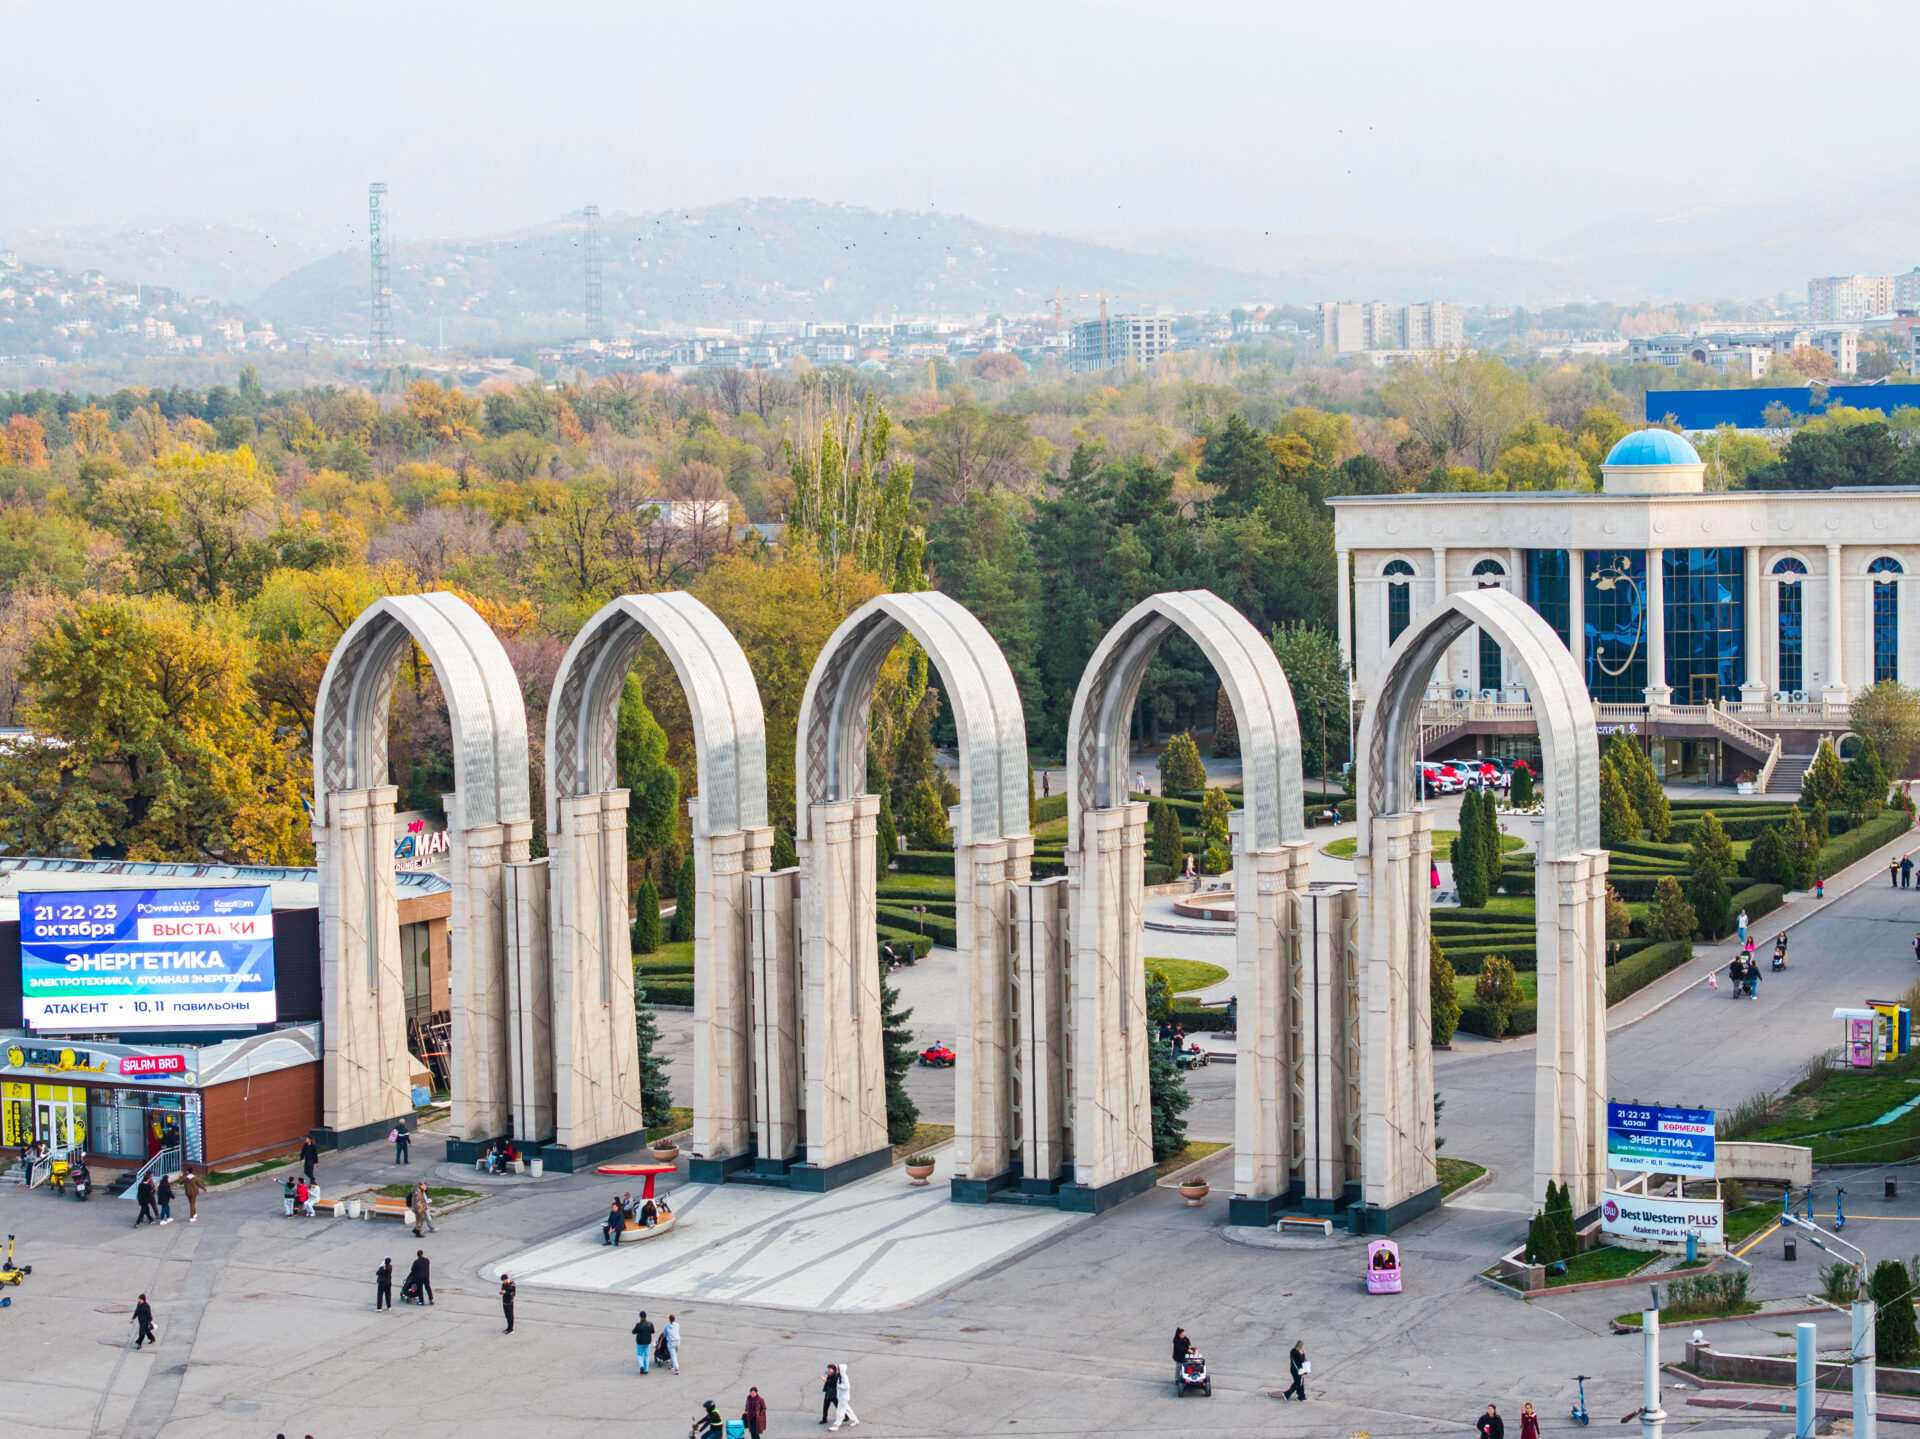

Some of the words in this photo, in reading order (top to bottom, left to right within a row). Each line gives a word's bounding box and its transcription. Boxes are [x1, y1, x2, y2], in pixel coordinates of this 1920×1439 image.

[34, 905, 53, 920] 21
[61, 904, 86, 920] 22
[93, 904, 118, 919] 23
[34, 921, 115, 938] октября
[153, 922, 255, 936] ВЫСТАКИ
[64, 951, 224, 972] ЭНЕРГЕТИКА
[136, 974, 189, 984] АТОМНАЯ
[191, 973, 262, 983] ЭНЕРГЕТИКА
[43, 1003, 108, 1015] АТАКЕНТ
[133, 1001, 151, 1014] 10,
[154, 1001, 164, 1012] 11
[173, 1002, 250, 1011] павильоны
[25, 1048, 90, 1067] LEMON
[123, 1060, 156, 1071] SALAM
[158, 1058, 178, 1069] BRO
[1617, 1110, 1625, 1118] 21
[1628, 1111, 1638, 1119] 22
[1640, 1112, 1651, 1120] 23
[1623, 1120, 1647, 1128] қазан
[1663, 1123, 1706, 1133] КӨРМЕЛЕР
[1629, 1134, 1693, 1149] ЭНЕРГЕТИКА
[1604, 1206, 1616, 1216] BW
[1621, 1208, 1642, 1221] Best
[1642, 1211, 1686, 1225] Western
[1688, 1215, 1718, 1226] PLUS
[1633, 1225, 1660, 1235] Atakent
[1661, 1229, 1678, 1237] Park
